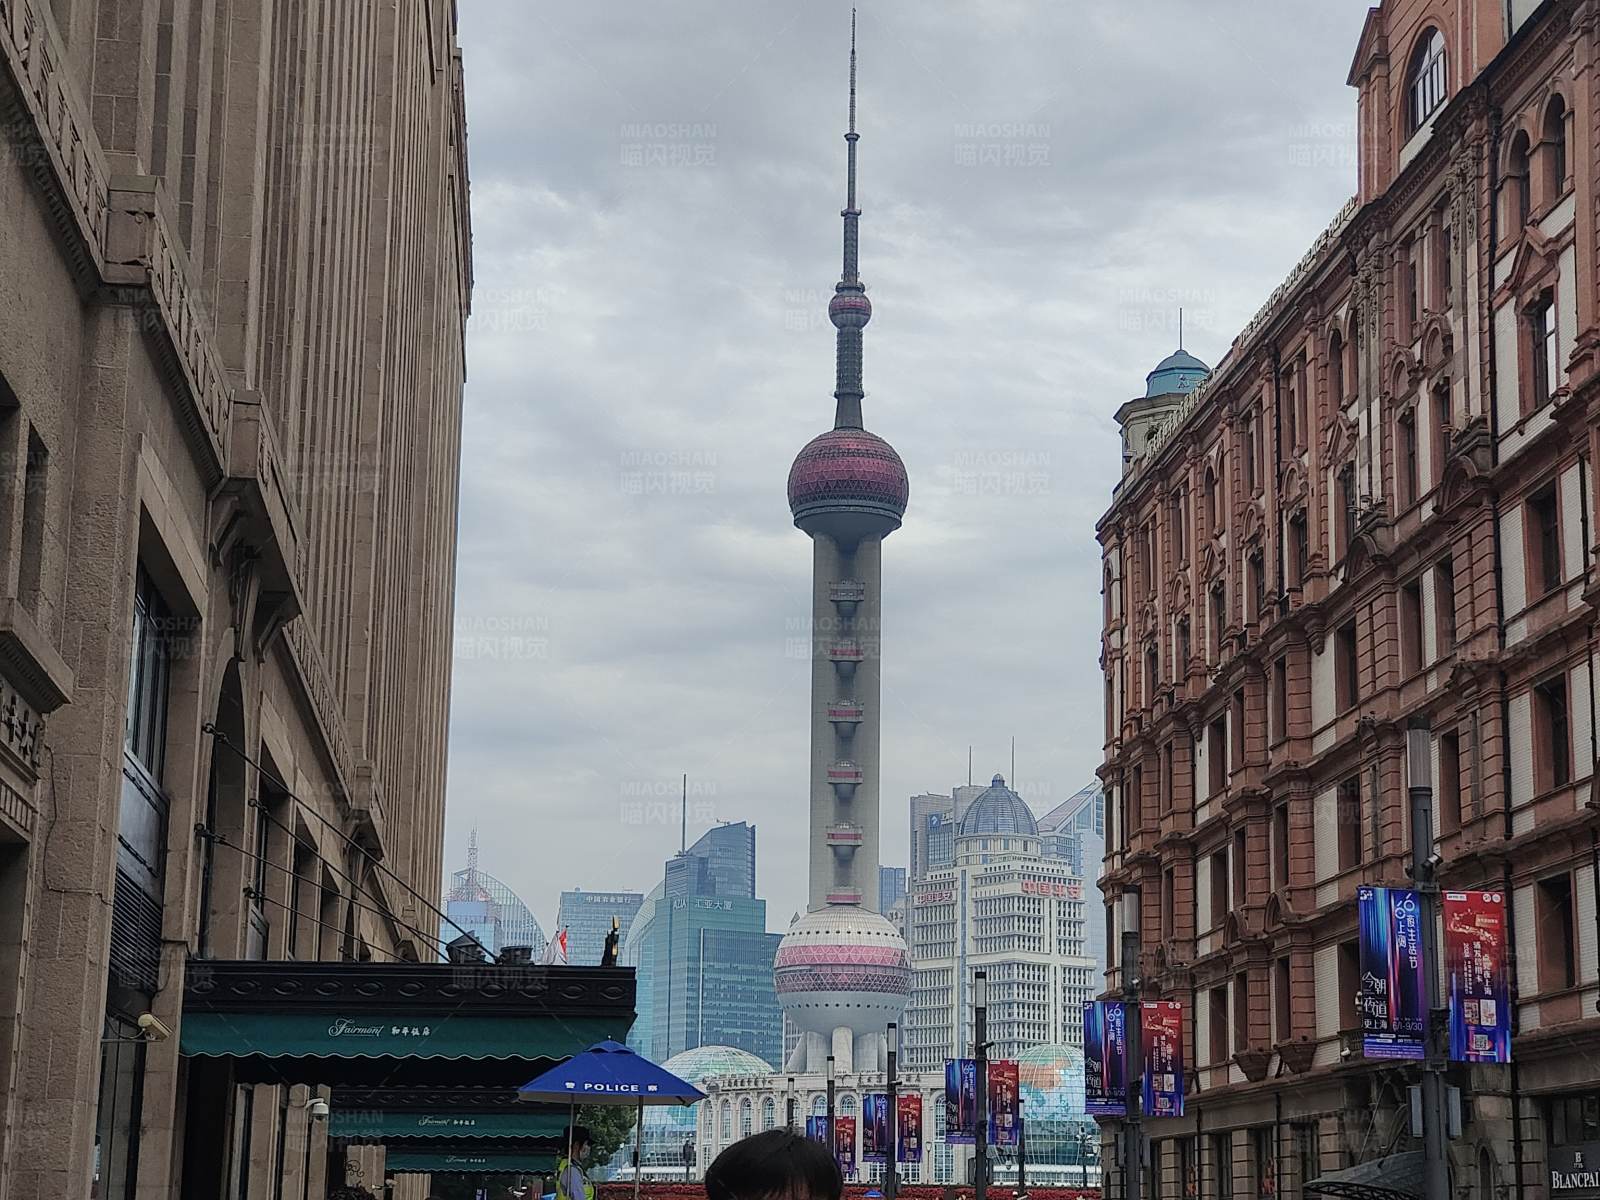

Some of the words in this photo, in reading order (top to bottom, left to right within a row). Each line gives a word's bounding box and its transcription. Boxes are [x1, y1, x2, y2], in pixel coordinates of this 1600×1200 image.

[1021, 880, 1082, 900] 中国平安
[694, 898, 735, 911] 汇亚大厦
[328, 1018, 385, 1037] Fairmont
[584, 1083, 640, 1092] POLICE
[1551, 1170, 1600, 1189] BLANCPAI
